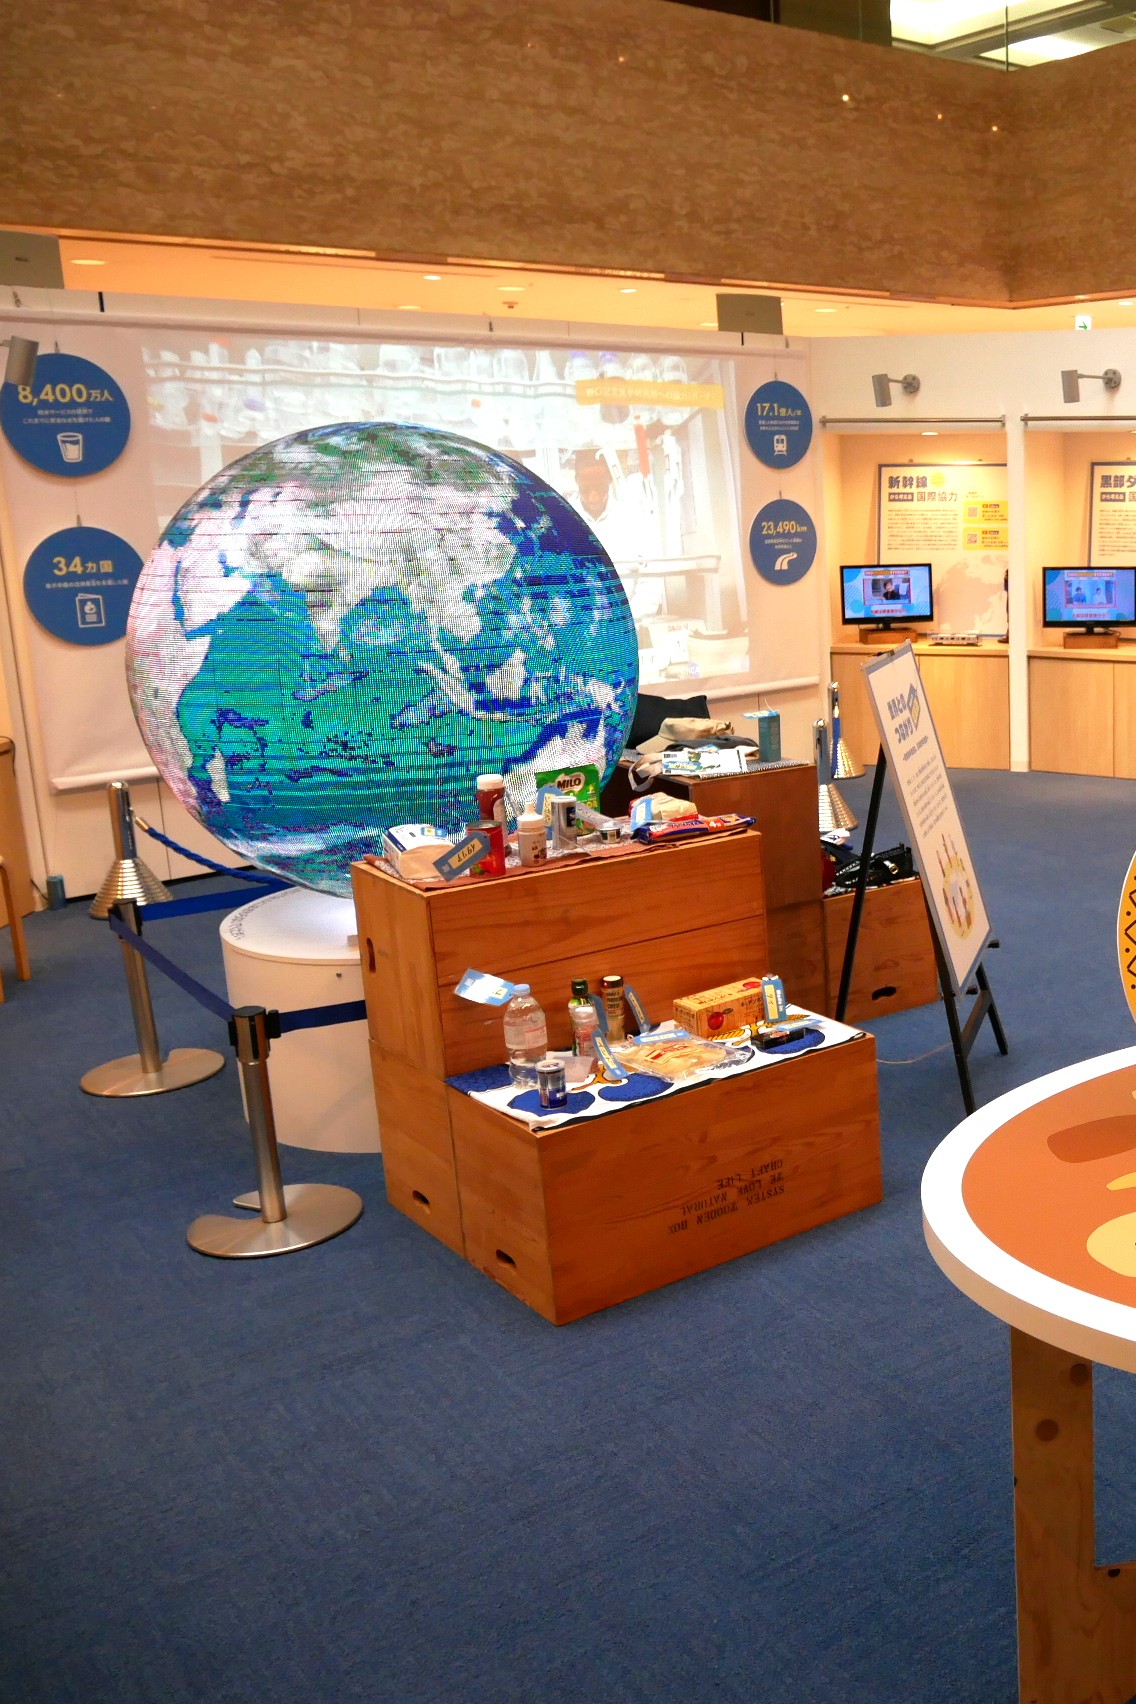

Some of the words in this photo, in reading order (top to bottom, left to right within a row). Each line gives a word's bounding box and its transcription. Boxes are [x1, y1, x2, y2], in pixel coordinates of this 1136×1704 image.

[17, 383, 114, 406] 8,400万人
[888, 476, 928, 489] 新幹線
[917, 492, 958, 502] 国際協力
[761, 521, 808, 536] 23,490km
[556, 777, 582, 790] MILO
